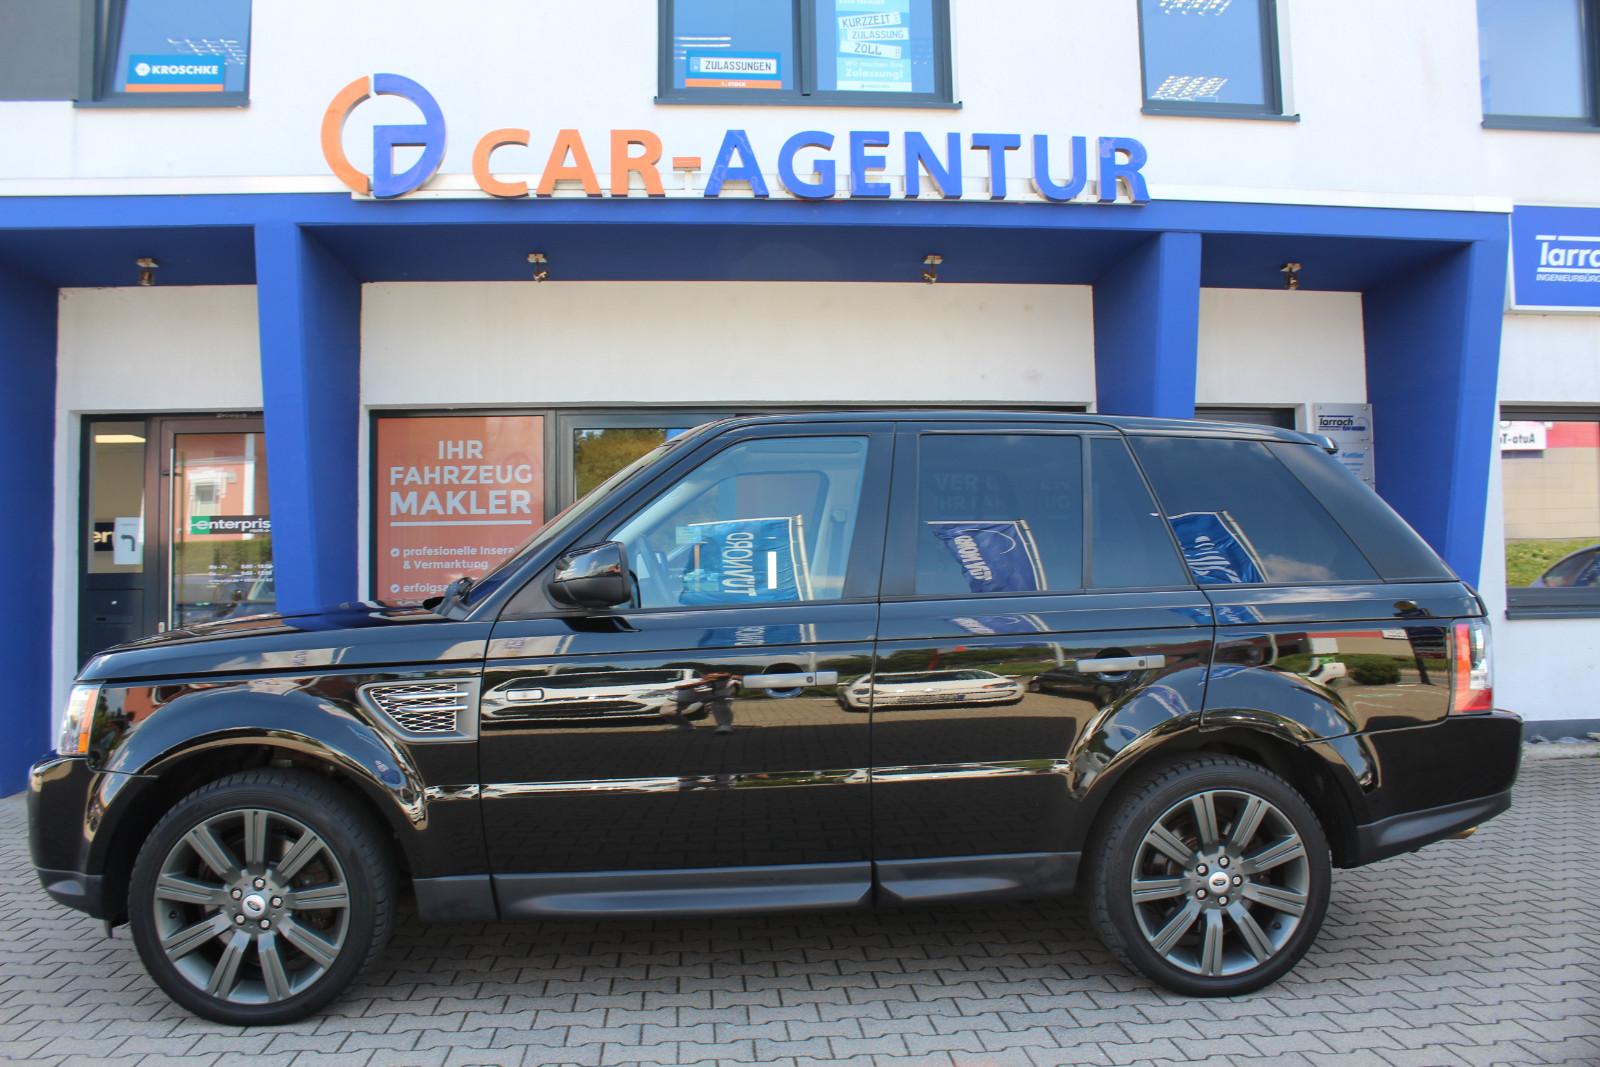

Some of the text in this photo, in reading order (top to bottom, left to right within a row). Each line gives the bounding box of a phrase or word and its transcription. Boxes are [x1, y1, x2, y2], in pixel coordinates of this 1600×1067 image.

[841, 14, 891, 28] KURZZEIT
[851, 30, 904, 40] ZULASSUNG
[854, 42, 882, 56] ZOLL
[151, 64, 219, 76] KROSCHKE
[704, 60, 771, 71] ZULASSUNGEN
[472, 128, 1150, 203] CAR-AGENTUR
[438, 440, 483, 460] IHR
[390, 464, 532, 485] FAHRZEUG
[390, 490, 531, 516] MAKLER
[194, 518, 271, 531] enterpris
[413, 559, 488, 570] Vermarktung
